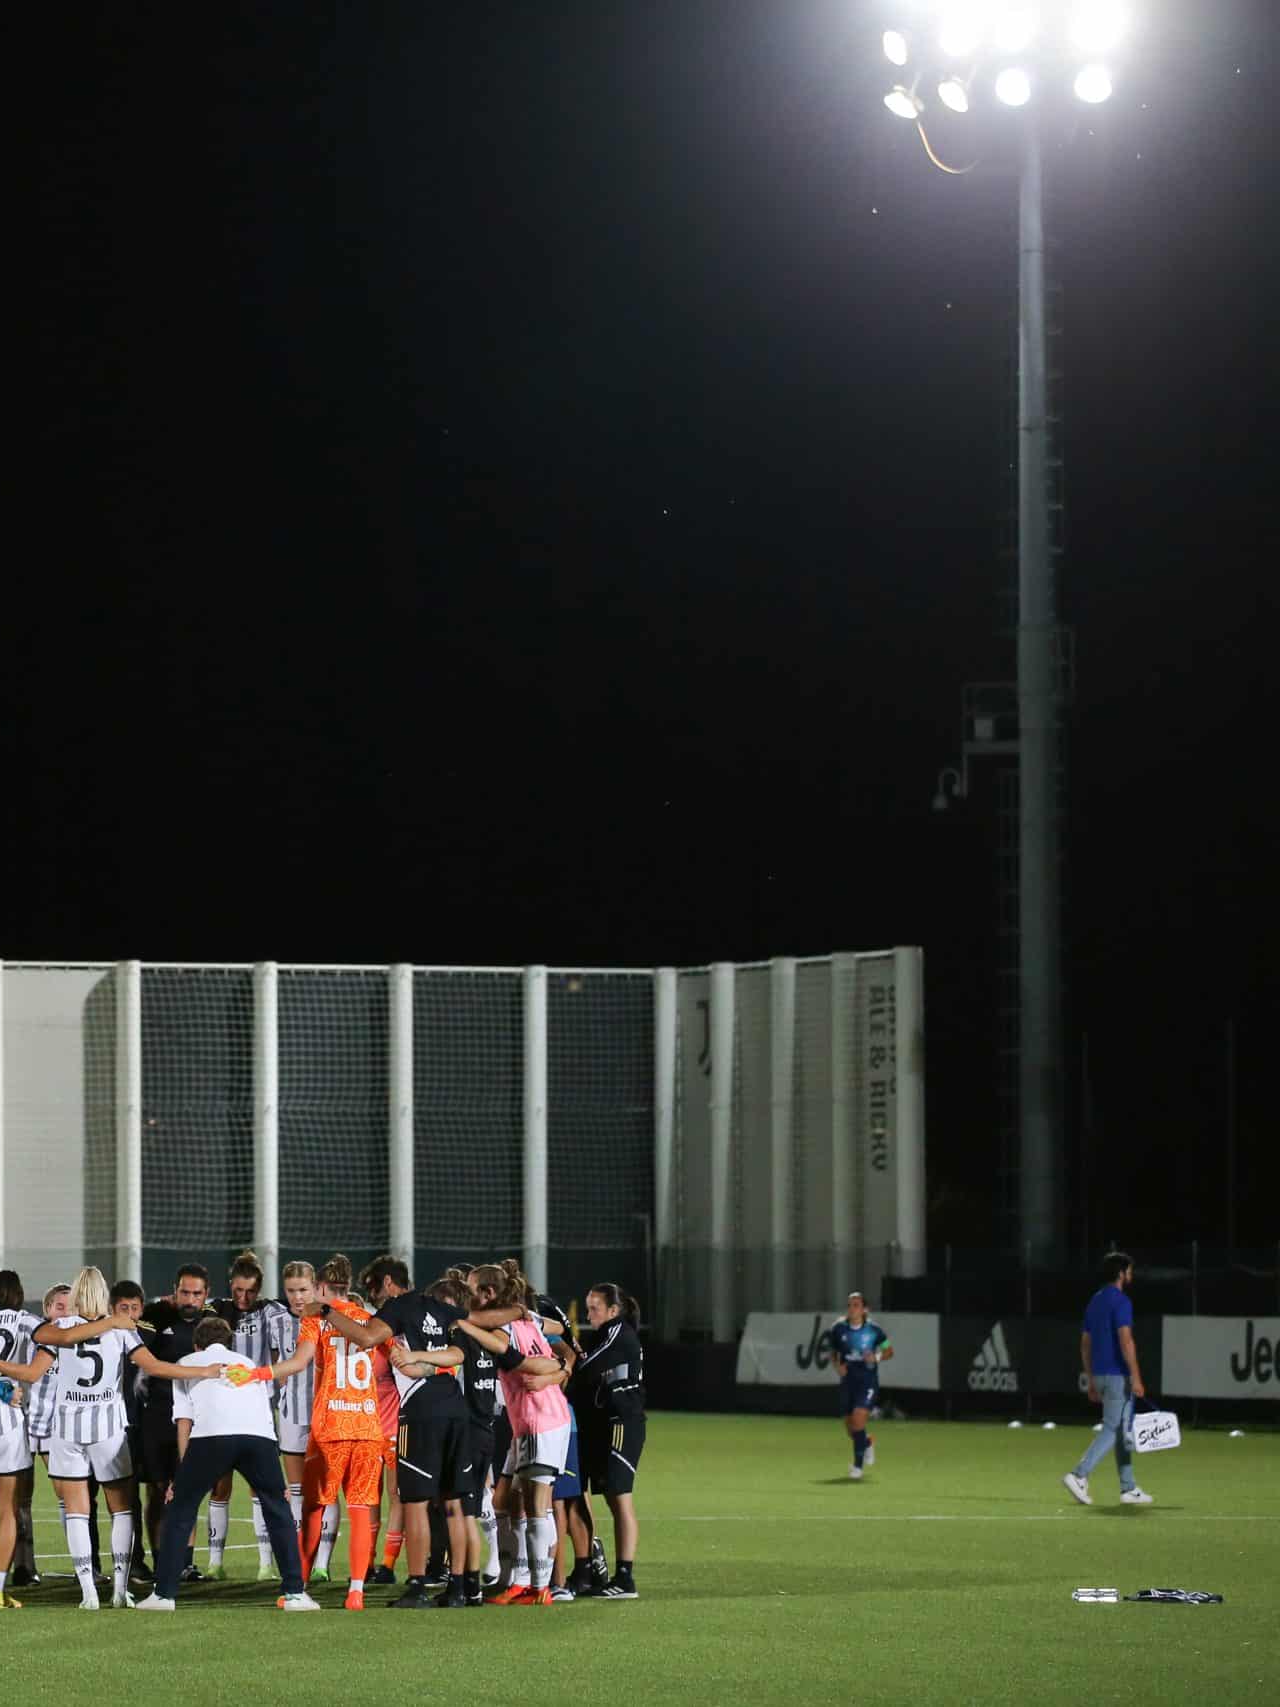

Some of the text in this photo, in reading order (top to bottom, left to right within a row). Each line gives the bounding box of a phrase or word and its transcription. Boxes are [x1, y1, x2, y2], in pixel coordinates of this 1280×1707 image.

[76, 1337, 103, 1388] 5
[330, 1337, 372, 1390] 16
[796, 1315, 833, 1370] Je
[1231, 1320, 1280, 1383] Je
[65, 1391, 100, 1402] Allianz
[968, 1368, 1018, 1391] adidas
[327, 1399, 362, 1412] Allianz
